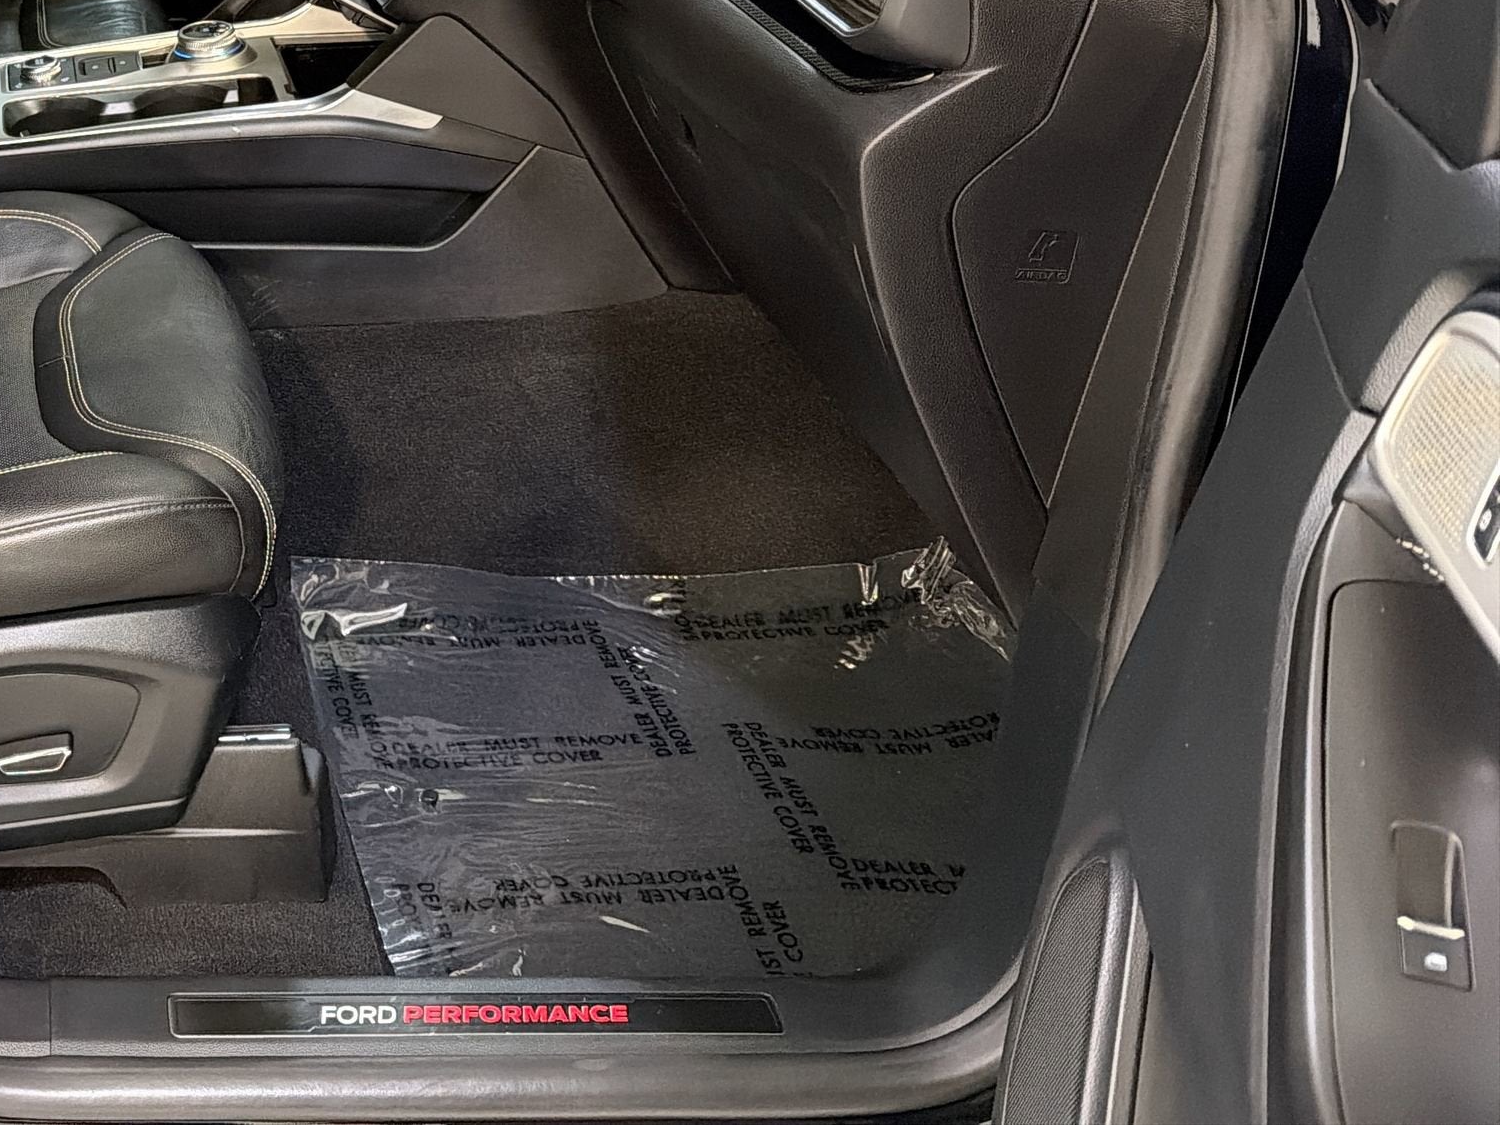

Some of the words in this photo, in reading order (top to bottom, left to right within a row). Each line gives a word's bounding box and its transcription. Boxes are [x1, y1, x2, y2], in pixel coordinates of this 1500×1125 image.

[700, 625, 815, 641] PROTECTIVE
[610, 675, 643, 705] MUST
[640, 684, 697, 755] PROTECTIVE
[889, 712, 1001, 741] ROTECTIVE
[484, 736, 540, 752] MUST
[553, 733, 643, 748] REMOVE
[634, 712, 674, 757] DEALER
[815, 726, 881, 741] COVER
[947, 728, 999, 749] ALER
[778, 736, 865, 754] REMOVE
[875, 741, 932, 755] MUST
[532, 749, 604, 765] COVER
[722, 722, 783, 800] PROTECTIVE
[773, 805, 814, 855] COVER
[745, 721, 787, 768] DEALER
[780, 774, 819, 817] MUST
[808, 824, 861, 890] REMOVE
[851, 858, 935, 876] DEALER
[580, 868, 717, 890] PROTECTIVE
[862, 876, 959, 895] PROTECT
[559, 887, 623, 906] MUST
[639, 884, 726, 906] DEALER
[718, 864, 767, 938] REMOVE
[763, 900, 803, 963] COVER
[320, 1004, 398, 1025] FORD
[403, 1004, 630, 1025] PERFORMANCE
